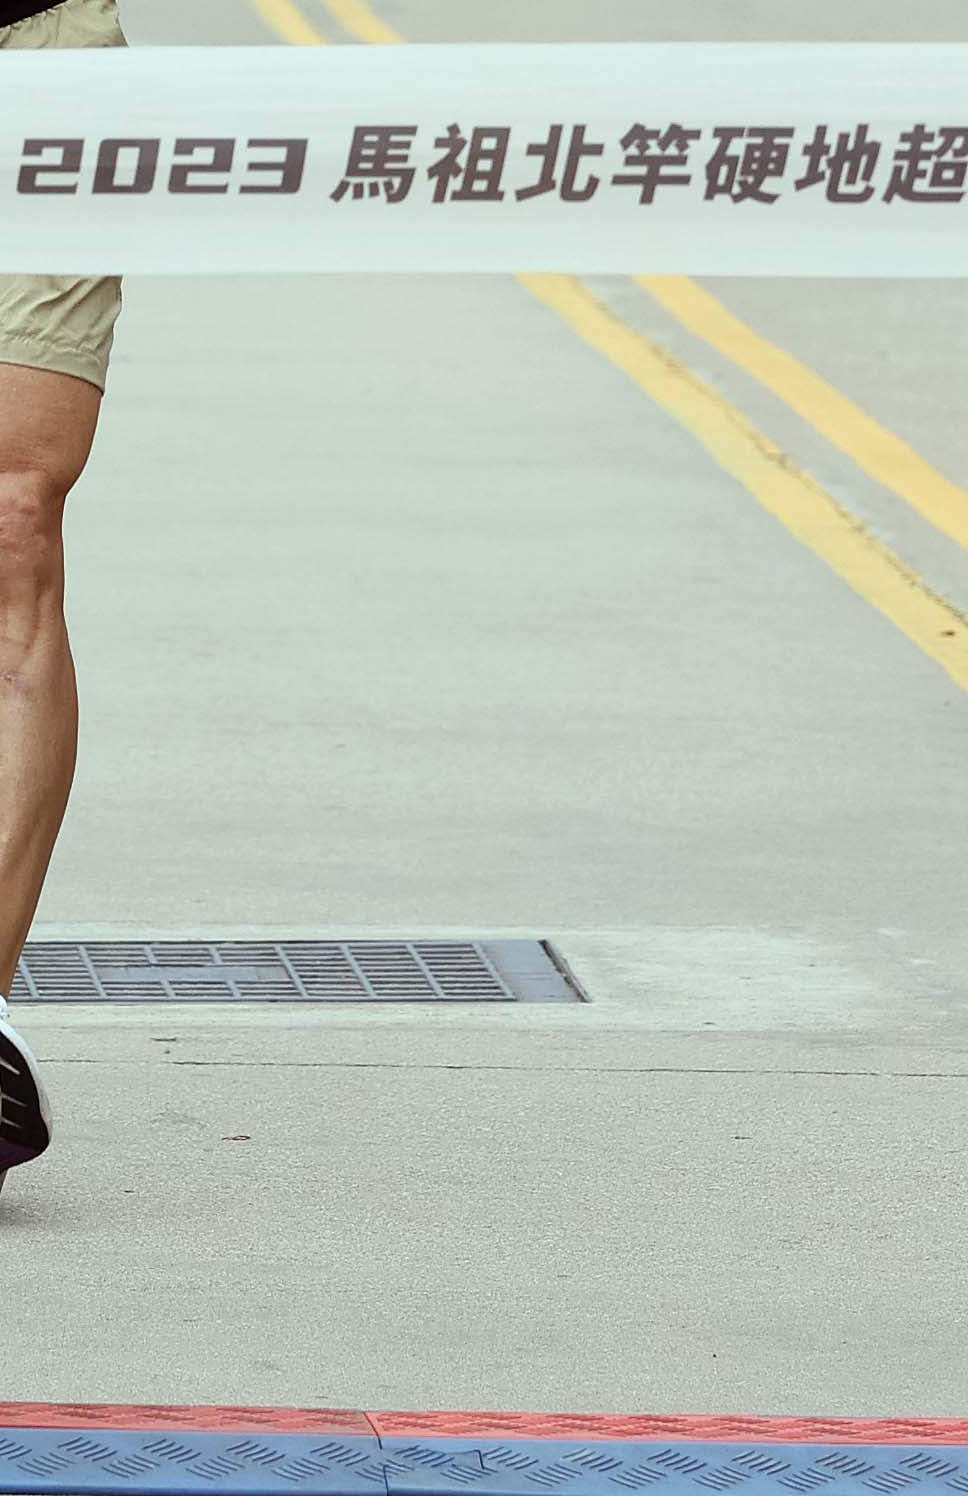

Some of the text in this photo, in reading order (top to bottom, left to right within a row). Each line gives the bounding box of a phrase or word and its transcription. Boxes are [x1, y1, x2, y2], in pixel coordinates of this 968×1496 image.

[16, 123, 968, 205] 2023 馬祖北竿硬地超
